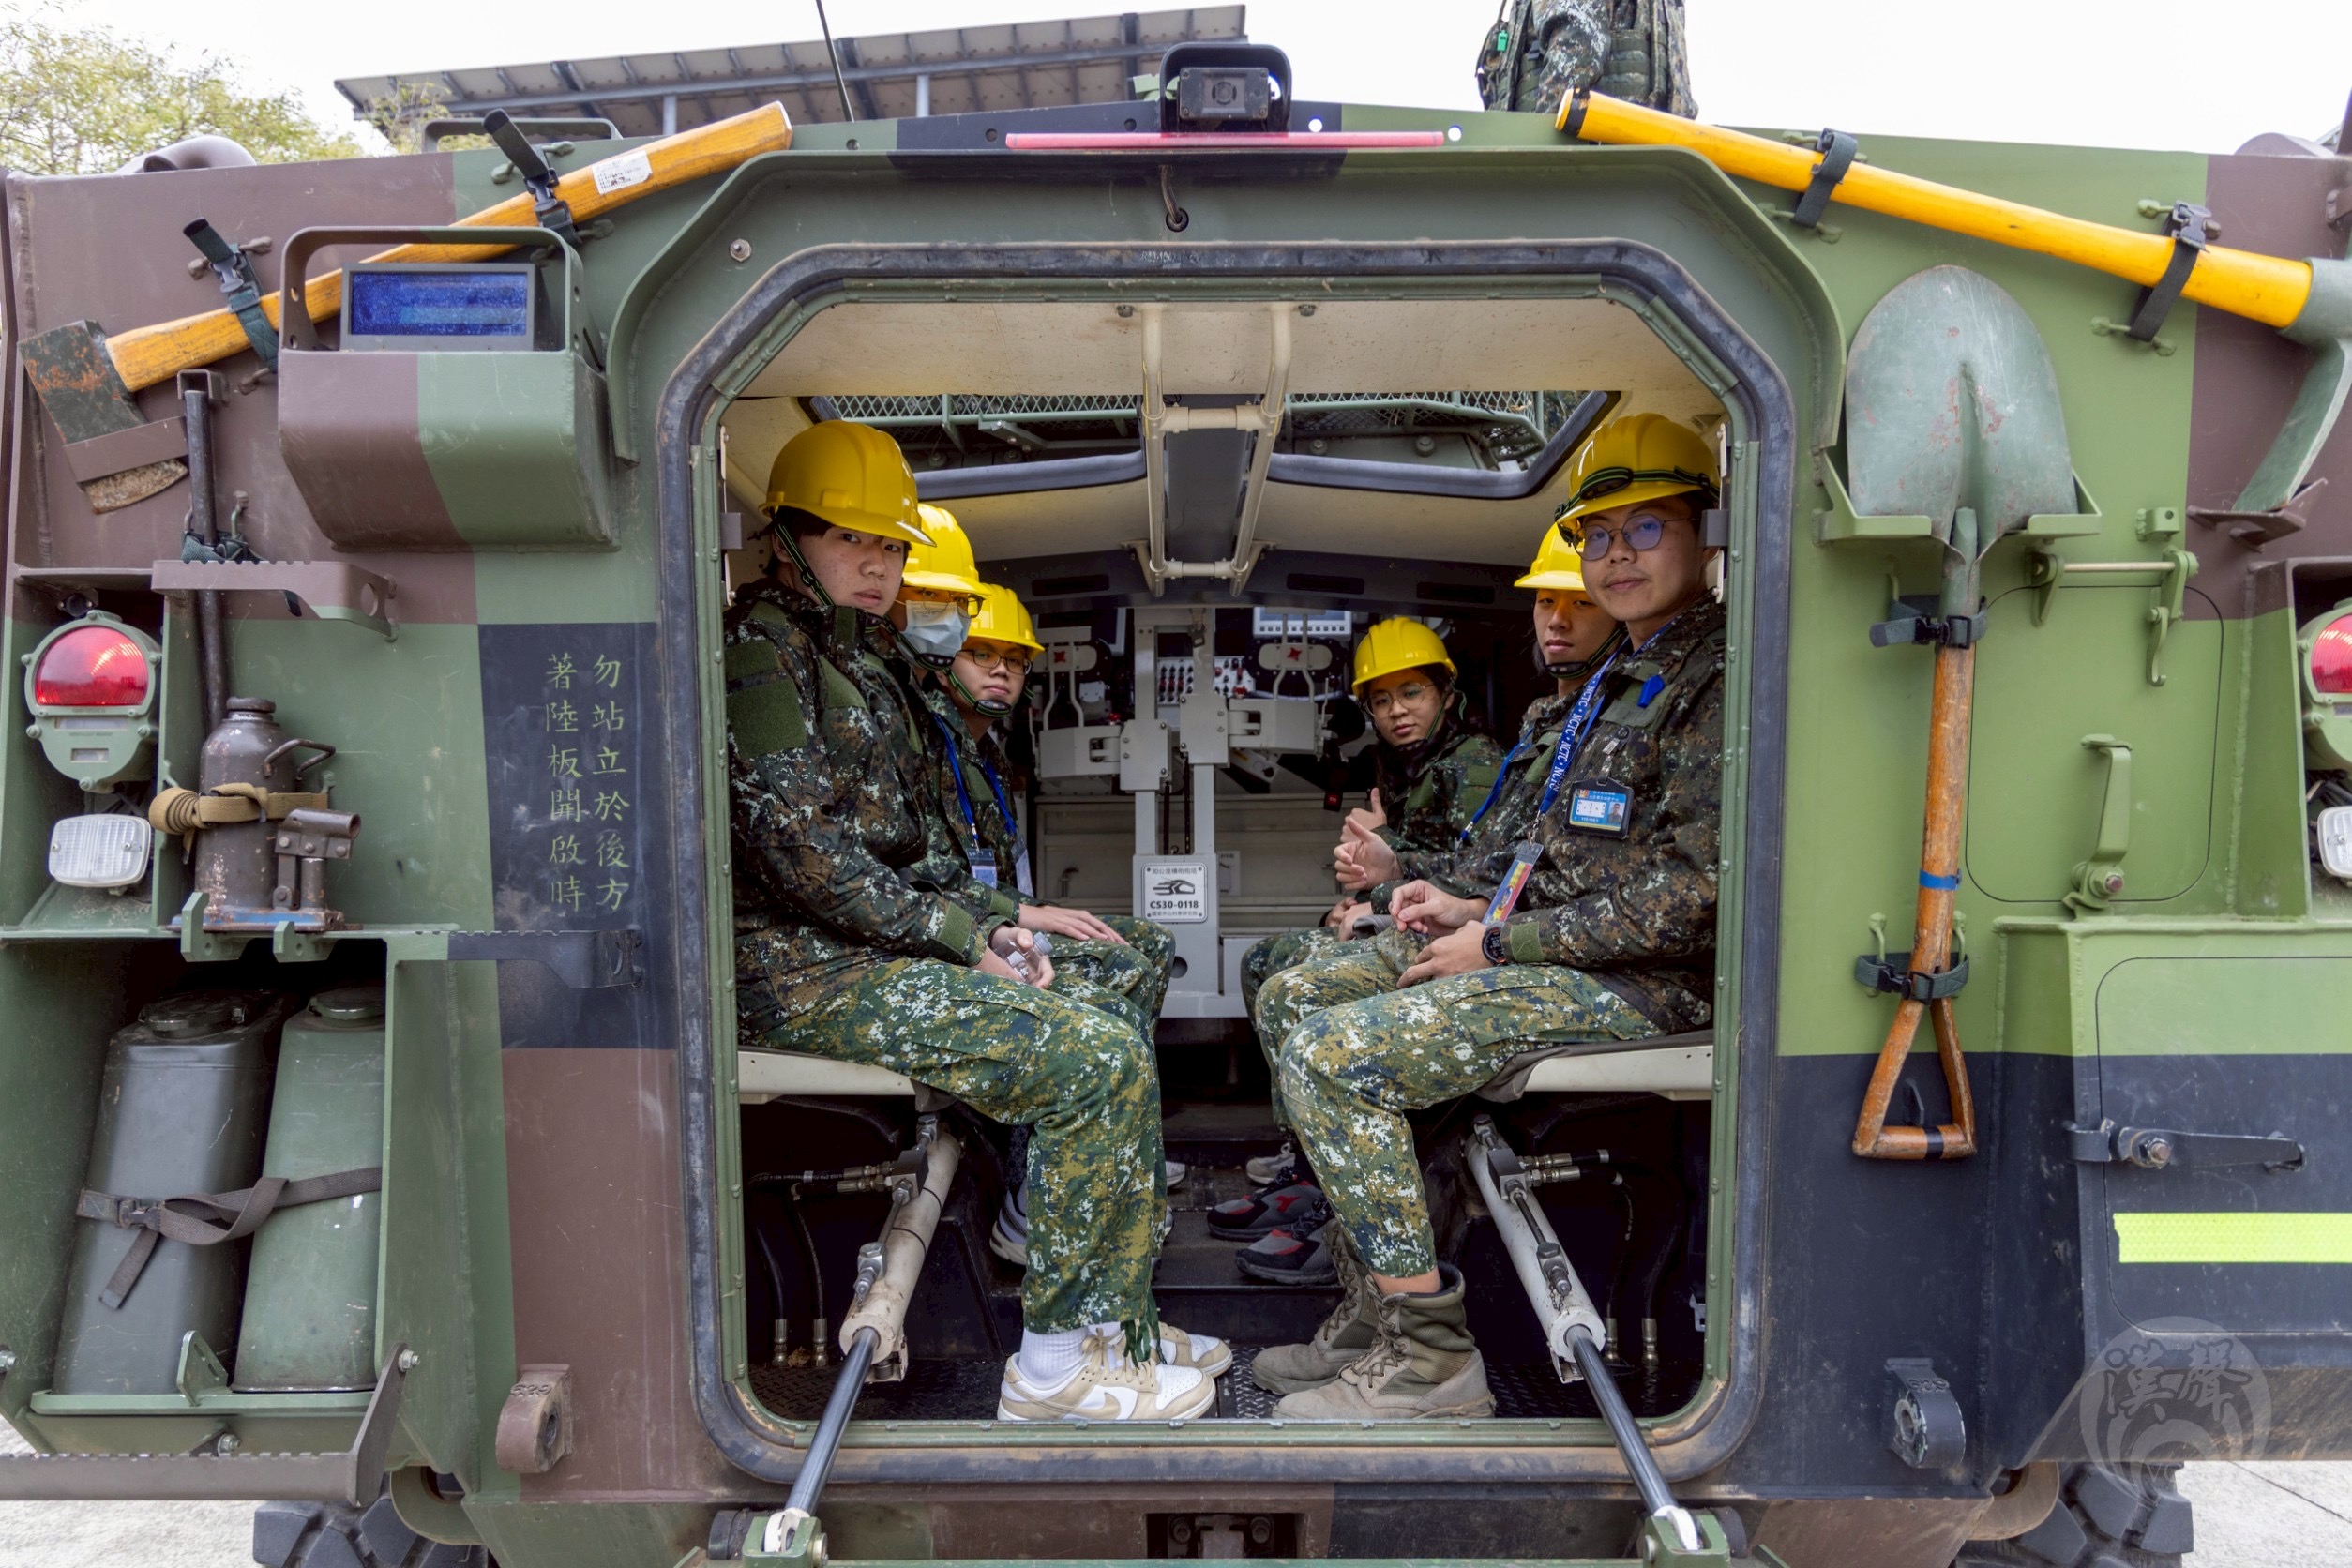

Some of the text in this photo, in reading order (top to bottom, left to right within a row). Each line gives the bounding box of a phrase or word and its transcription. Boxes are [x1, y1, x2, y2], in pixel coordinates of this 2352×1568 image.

[1564, 713, 1583, 736] NCTC
[1557, 740, 1572, 762] NCTC
[591, 654, 630, 912] 勿站立於後方
[1150, 900, 1199, 909] CS30-0118
